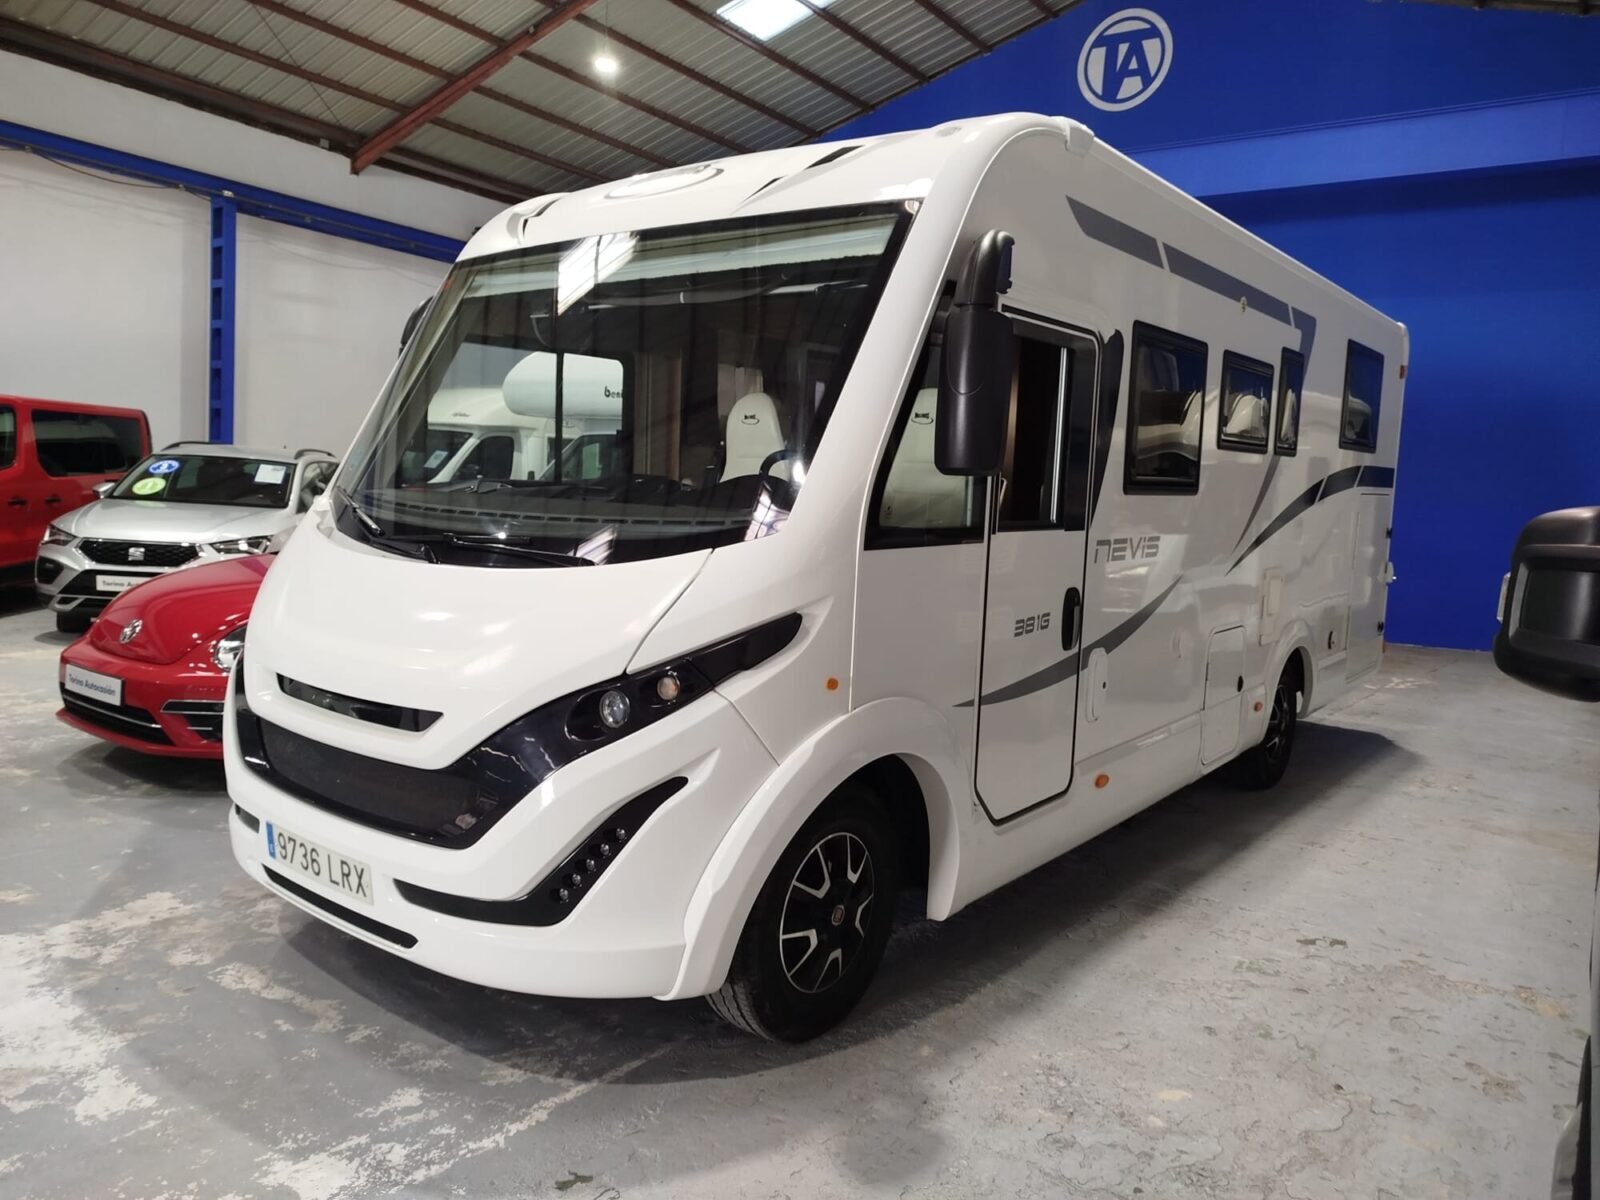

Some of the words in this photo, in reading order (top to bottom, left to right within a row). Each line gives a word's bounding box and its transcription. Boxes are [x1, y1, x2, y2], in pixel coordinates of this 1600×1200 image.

[1094, 535, 1161, 564] NEVIS
[277, 831, 321, 877] 9736
[327, 853, 367, 898] LRX
